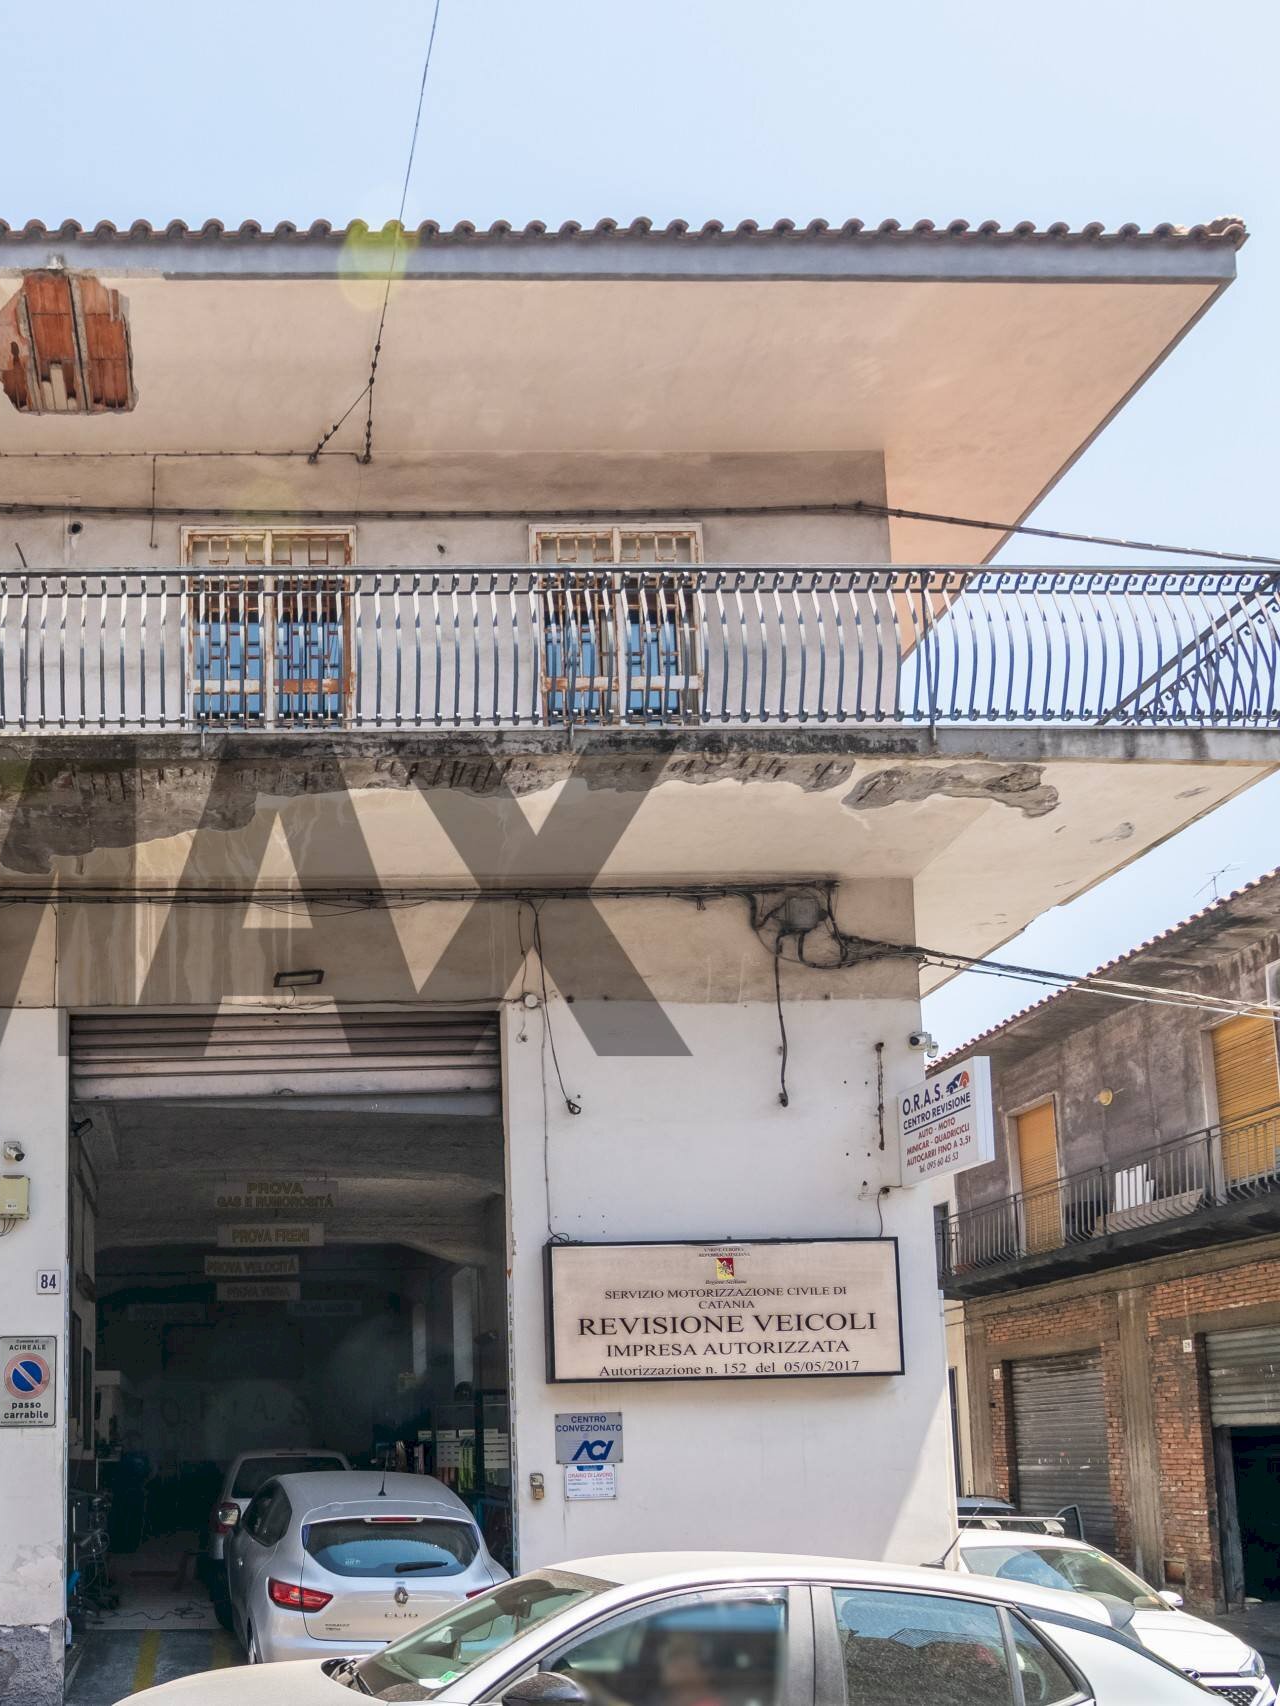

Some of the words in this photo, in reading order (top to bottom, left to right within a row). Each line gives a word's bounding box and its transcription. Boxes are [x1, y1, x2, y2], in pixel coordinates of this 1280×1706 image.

[902, 1083, 944, 1116] O.R.A.S.
[903, 1110, 931, 1130] CENTRO
[931, 1091, 971, 1118] REVISIONE
[918, 1126, 934, 1140] AUTO
[938, 1116, 956, 1131] MOTO
[906, 1139, 930, 1156] MINICAR
[934, 1122, 970, 1144] QUADRICICLI
[906, 1148, 937, 1168] AUTOCARRI
[937, 1142, 952, 1155] FINO
[953, 1139, 958, 1149] A
[247, 1182, 304, 1194] PROVA
[231, 1229, 272, 1243] PROVA
[40, 1273, 56, 1289] 84
[604, 1290, 664, 1300] SERVIZIO
[667, 1287, 783, 1298] MOTORIZZAZIONE
[786, 1286, 830, 1296] CIVILE
[833, 1286, 847, 1295] DI
[698, 1300, 755, 1310] CATANIA
[577, 1315, 744, 1336] REVISIONE
[752, 1312, 878, 1333] VEICOLI
[606, 1343, 697, 1357] IMPRESA
[703, 1340, 850, 1356] AUTORIZZATA
[599, 1364, 701, 1376] Autorizzazione
[705, 1366, 718, 1374] n.
[724, 1363, 746, 1374] 152
[755, 1361, 775, 1373] del
[784, 1360, 860, 1372] 05/05/2017
[11, 1402, 41, 1410] passo
[3, 1411, 49, 1419] carrabile
[570, 1415, 607, 1424] CENTRO
[555, 1424, 623, 1432] CONVEZIONATO
[571, 1439, 615, 1461] ACI
